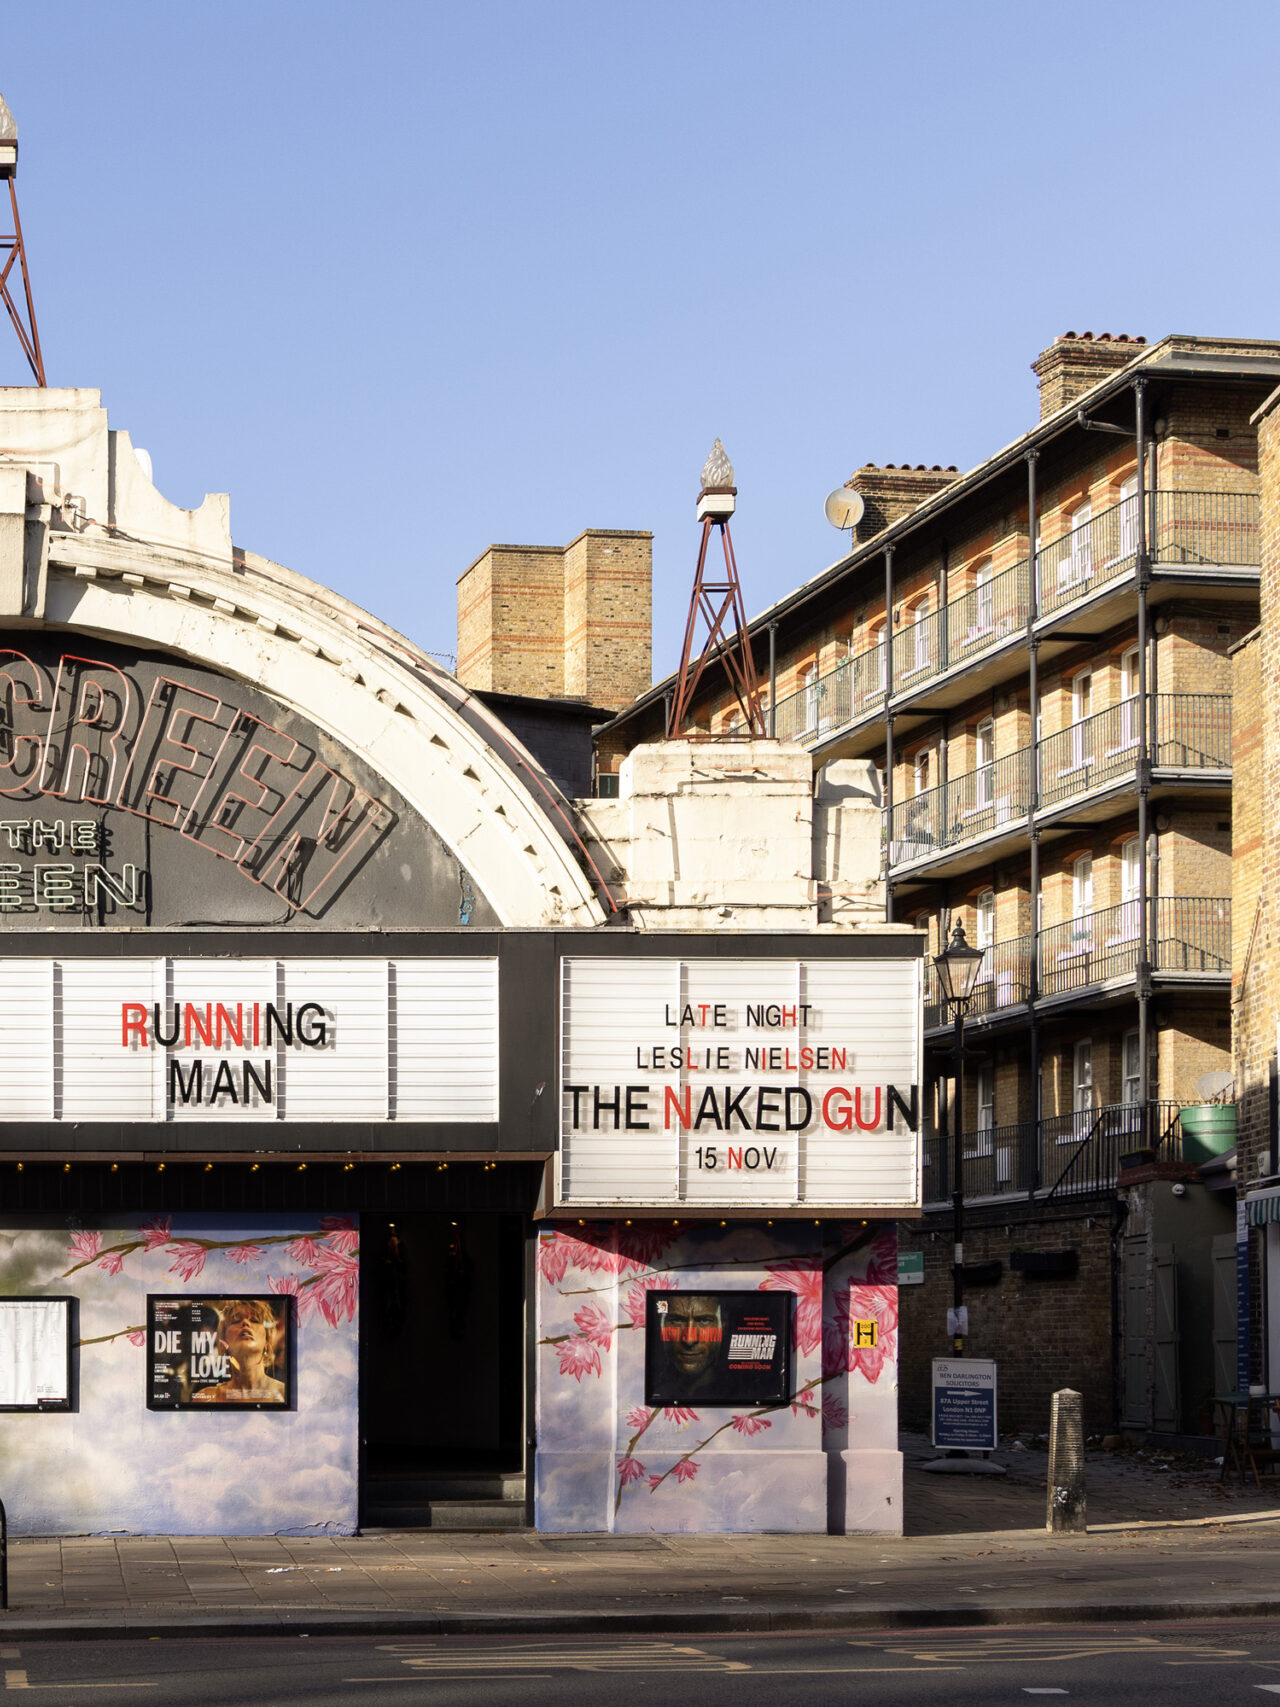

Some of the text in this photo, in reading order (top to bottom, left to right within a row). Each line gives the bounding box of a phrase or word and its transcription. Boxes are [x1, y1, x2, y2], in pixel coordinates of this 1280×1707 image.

[0, 819, 98, 849] THE
[121, 1002, 326, 1047] RUNNING
[666, 1004, 812, 1027] LATE NIGHT
[637, 1047, 847, 1070] LESLIE NIELSEN
[170, 1059, 273, 1104] MAN
[563, 1084, 920, 1132] THE NAKED GUN
[695, 1147, 777, 1170] 15 NOV
[154, 1330, 218, 1354] DIE MY
[730, 1334, 777, 1348] RUNNING
[752, 1347, 774, 1360] MAN
[191, 1355, 231, 1378] LOVE
